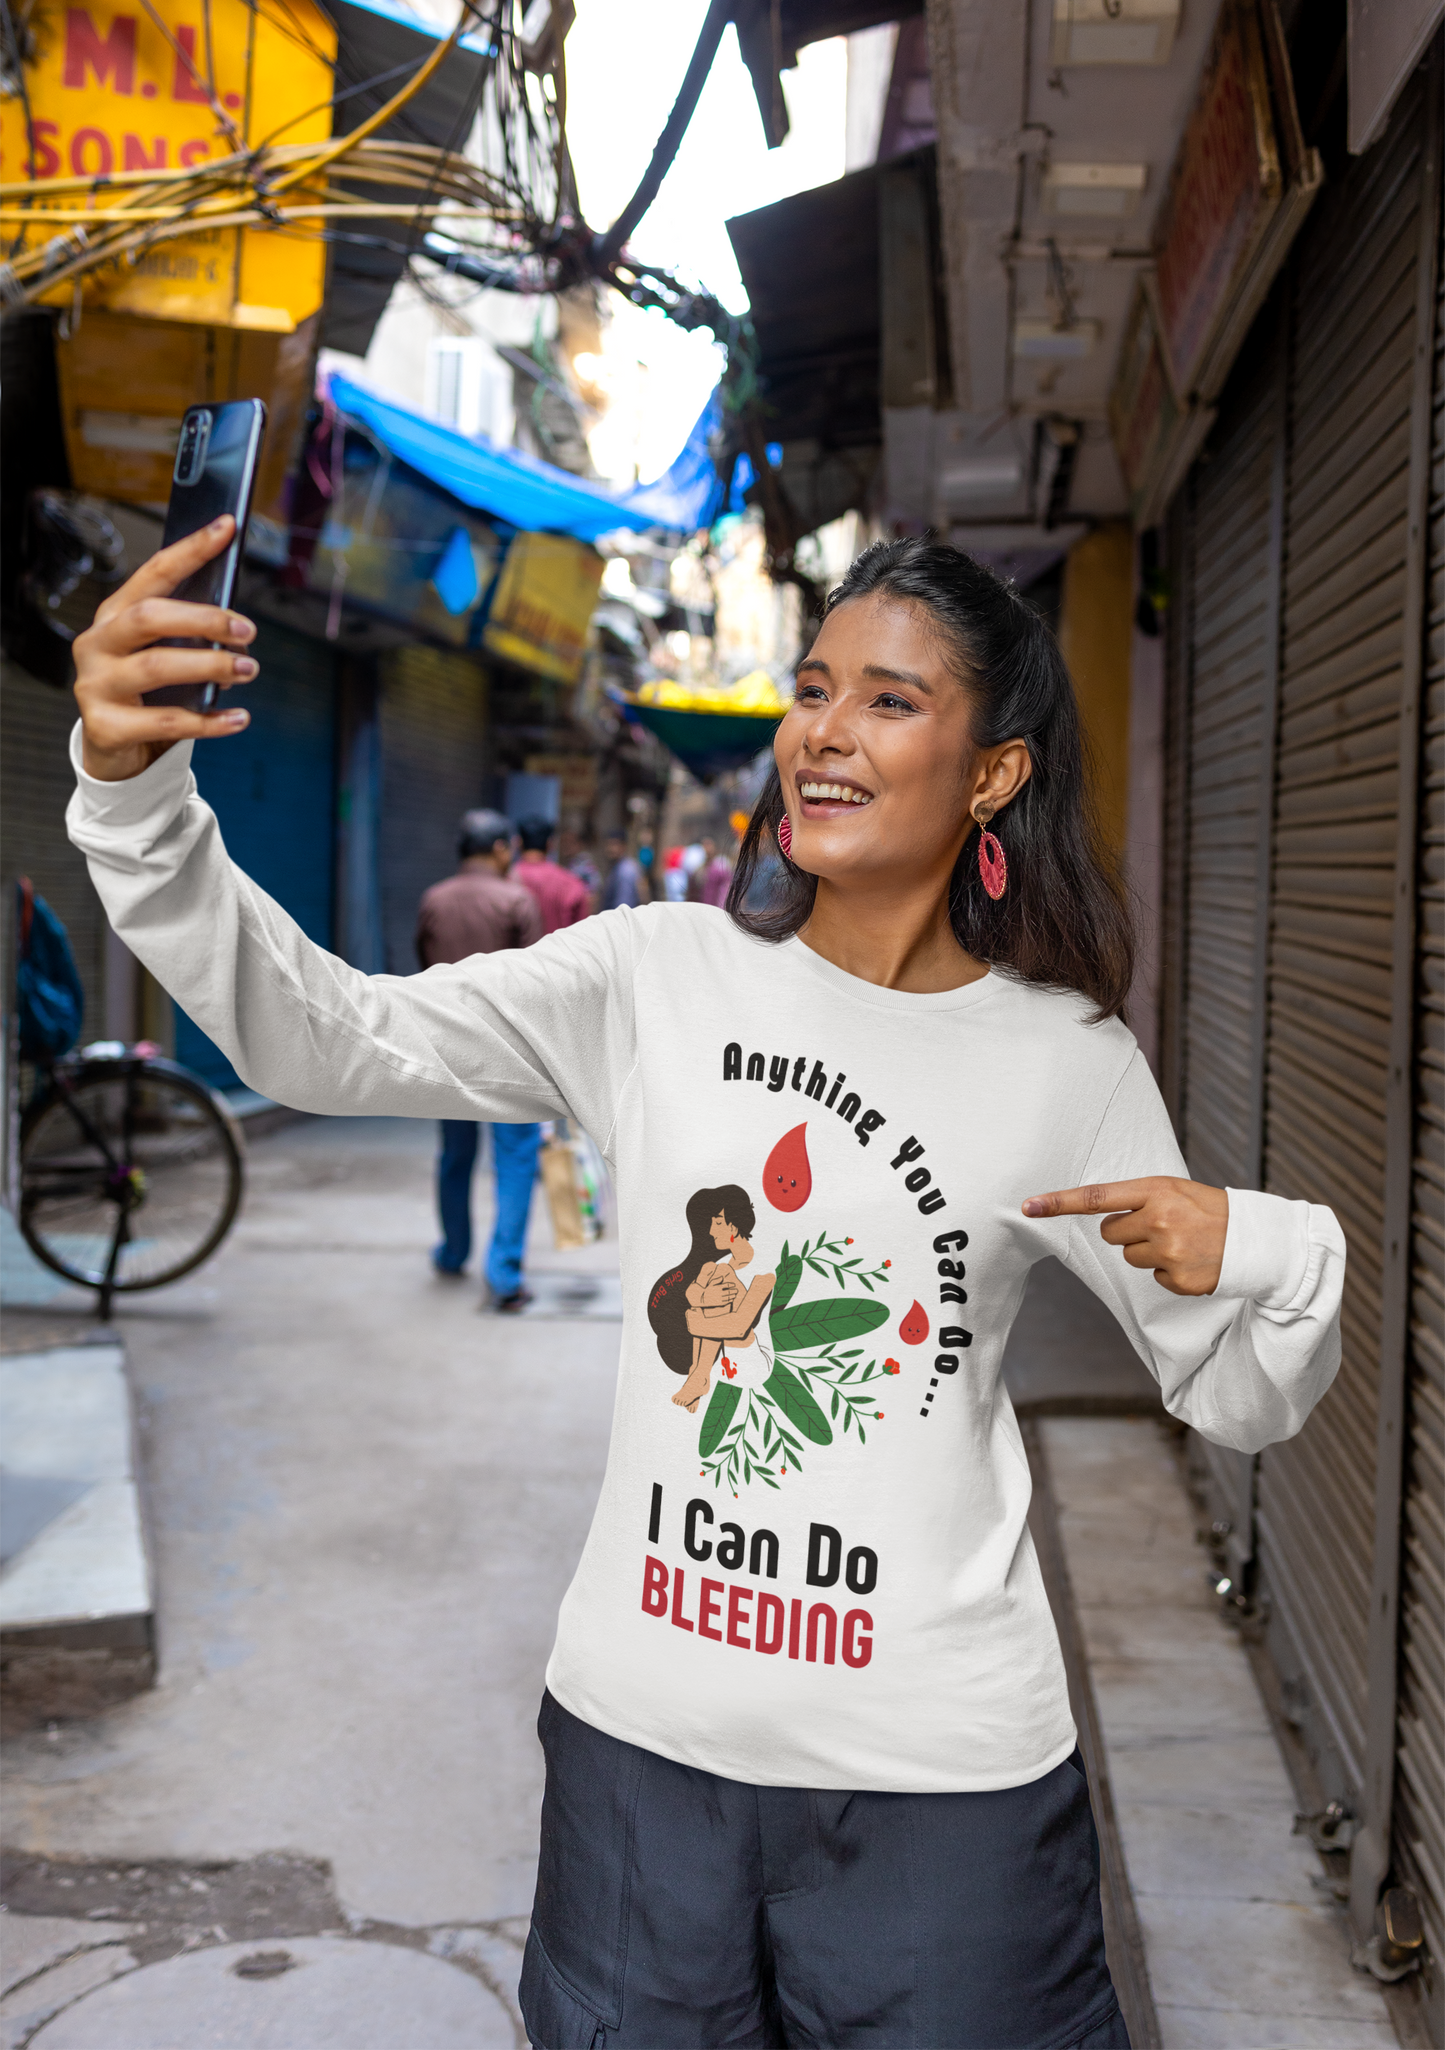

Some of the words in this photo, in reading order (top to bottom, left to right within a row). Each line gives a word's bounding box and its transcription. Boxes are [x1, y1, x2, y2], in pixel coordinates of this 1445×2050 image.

[62, 7, 244, 109] M.L.
[723, 1042, 887, 1148] Anything
[890, 1135, 947, 1216] You
[932, 1229, 969, 1305] Can
[651, 1285, 668, 1309] Buzz
[664, 1270, 684, 1287] Girls
[648, 1482, 663, 1544] I
[683, 1498, 780, 1579] Can
[805, 1522, 879, 1595] Do
[641, 1554, 874, 1669] BLEEDING
